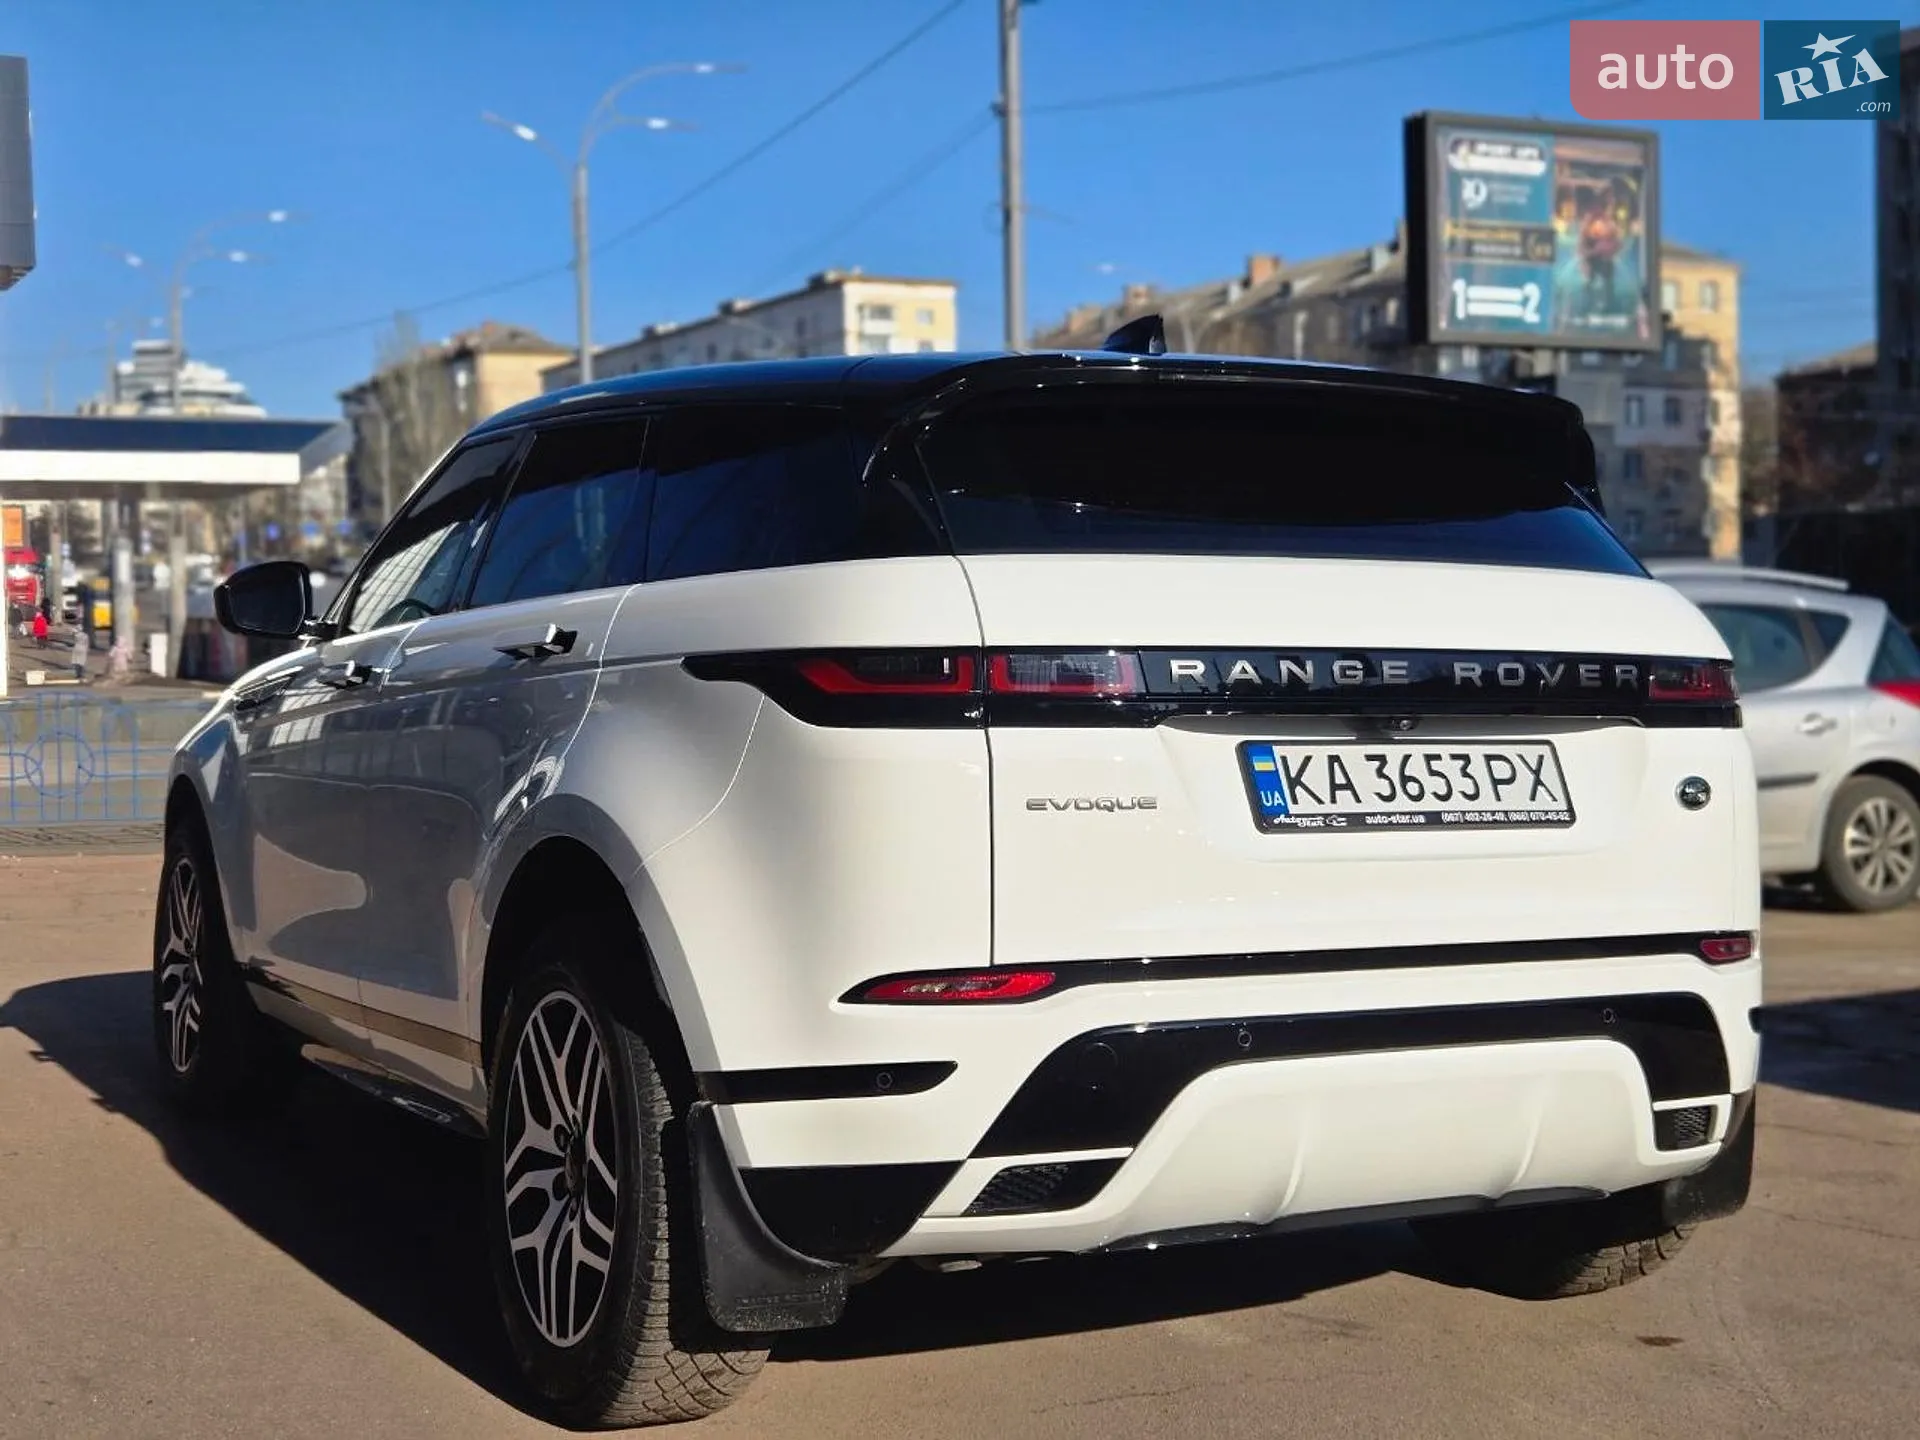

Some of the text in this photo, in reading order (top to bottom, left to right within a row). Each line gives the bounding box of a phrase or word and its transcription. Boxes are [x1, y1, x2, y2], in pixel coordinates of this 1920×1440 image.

[1169, 659, 1640, 689] RANGE ROVER
[1279, 753, 1558, 805] KA 3653 PX
[1026, 796, 1158, 812] EVOQUE
[1260, 790, 1285, 807] UA
